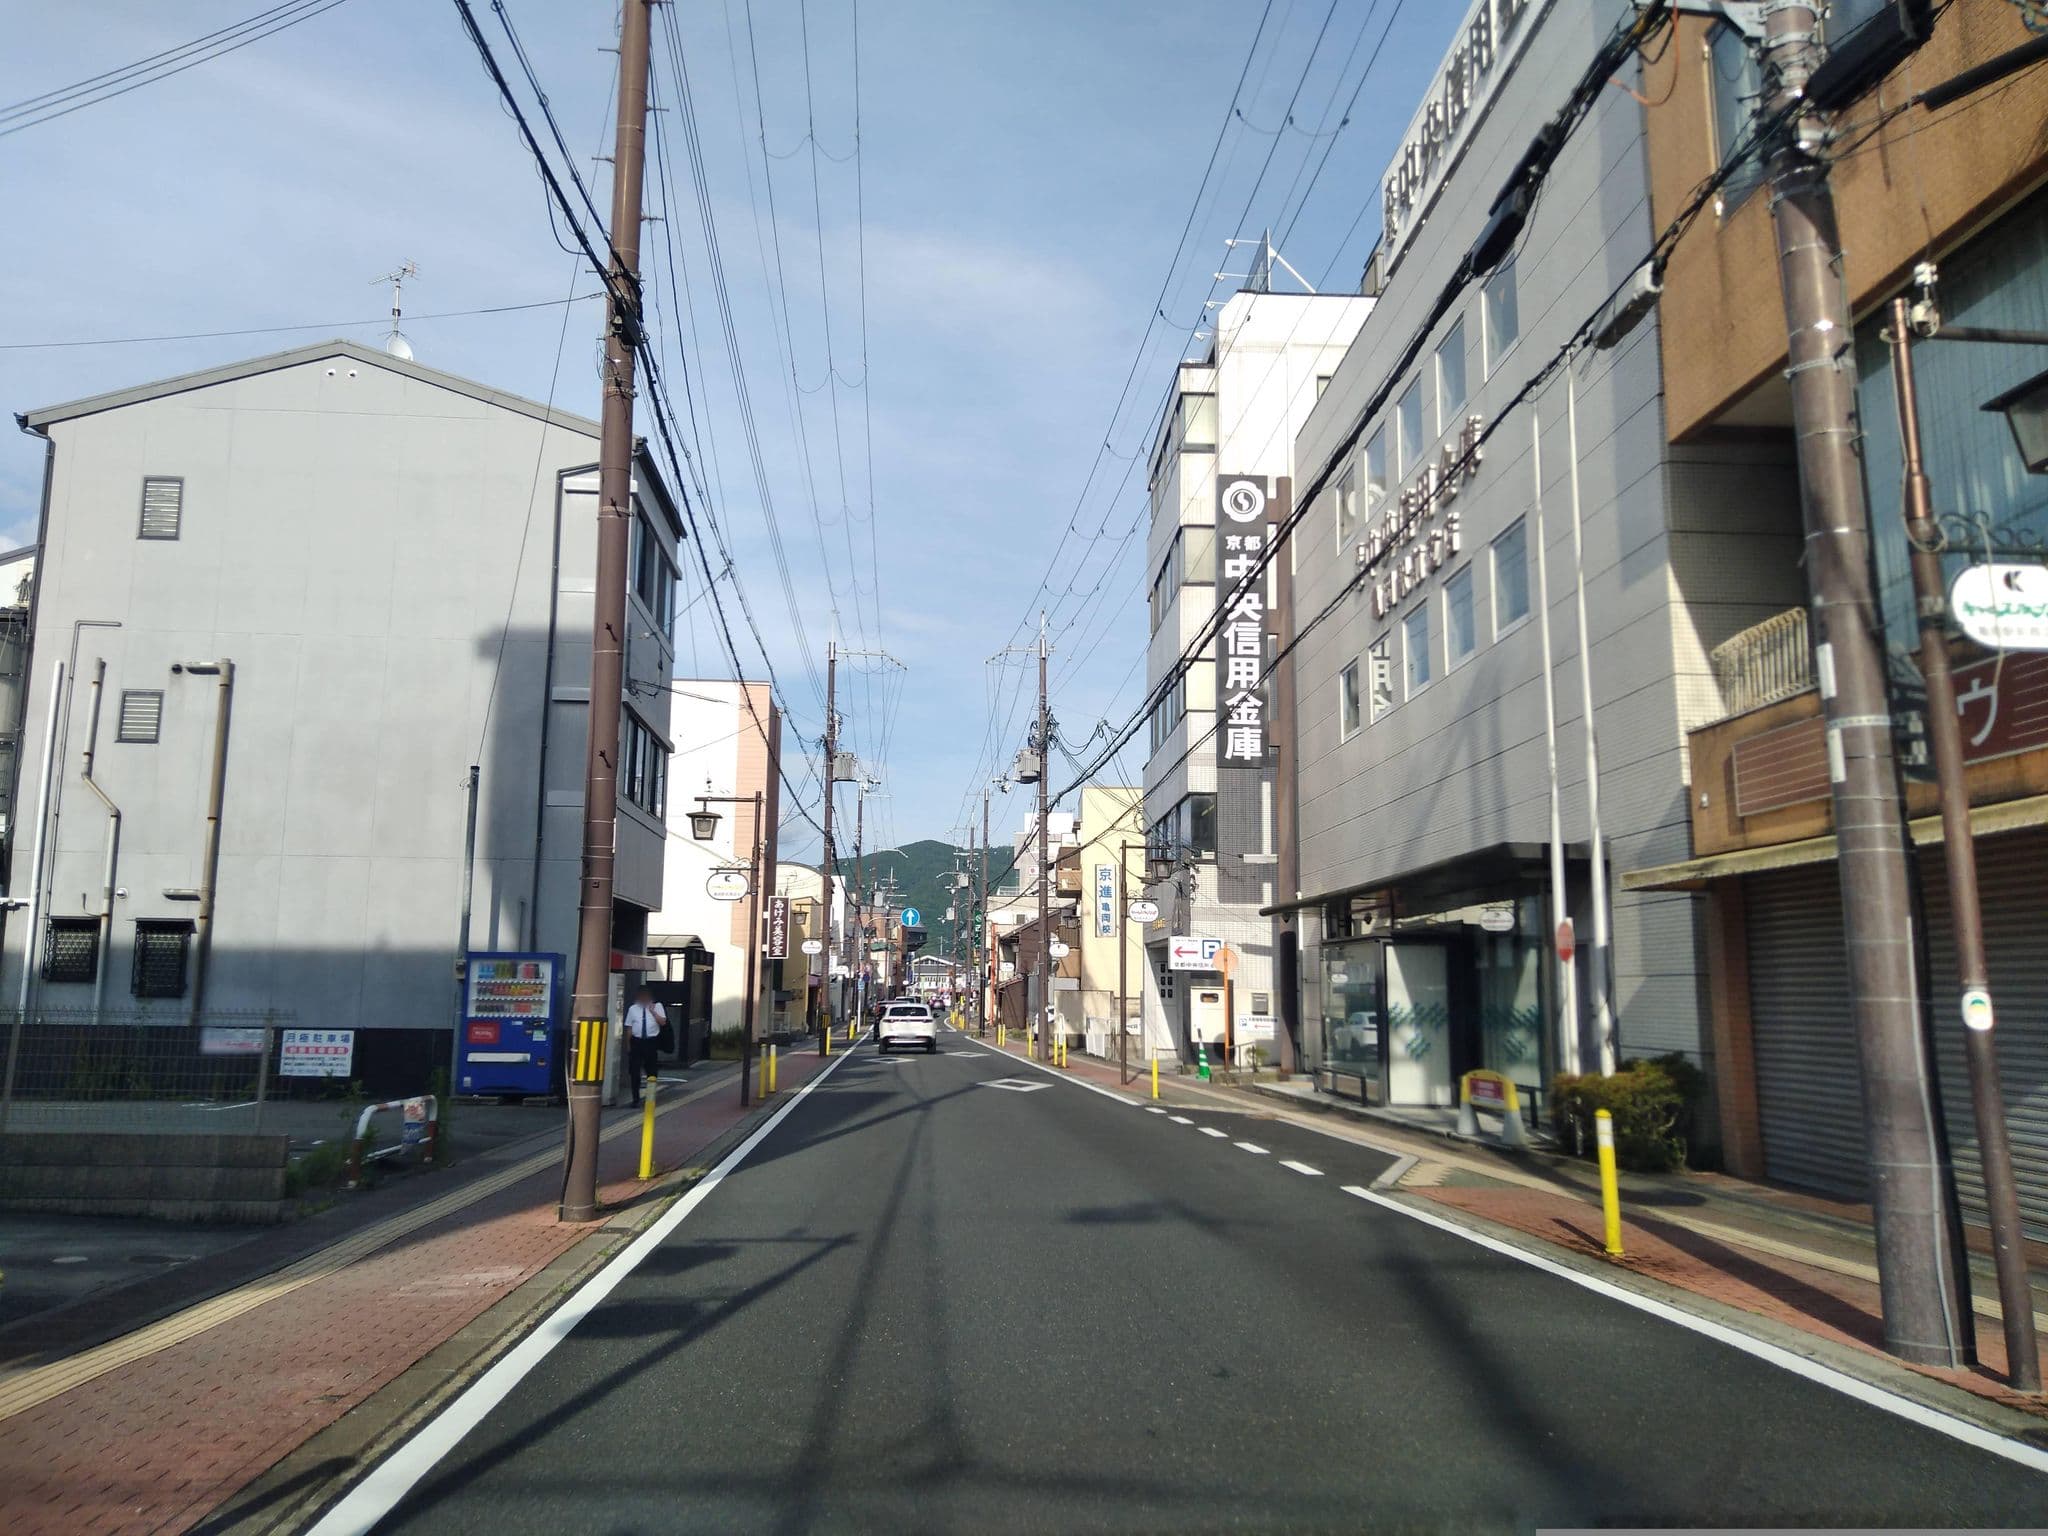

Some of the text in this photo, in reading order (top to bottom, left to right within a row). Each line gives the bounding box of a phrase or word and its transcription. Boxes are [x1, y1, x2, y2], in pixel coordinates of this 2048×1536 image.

[1225, 535, 1261, 551] 京都
[1223, 554, 1264, 761] 中央信用金庫
[1099, 868, 1112, 899] 京進
[772, 900, 785, 956] あけみ美容室
[286, 1032, 350, 1043] 月極駐車場
